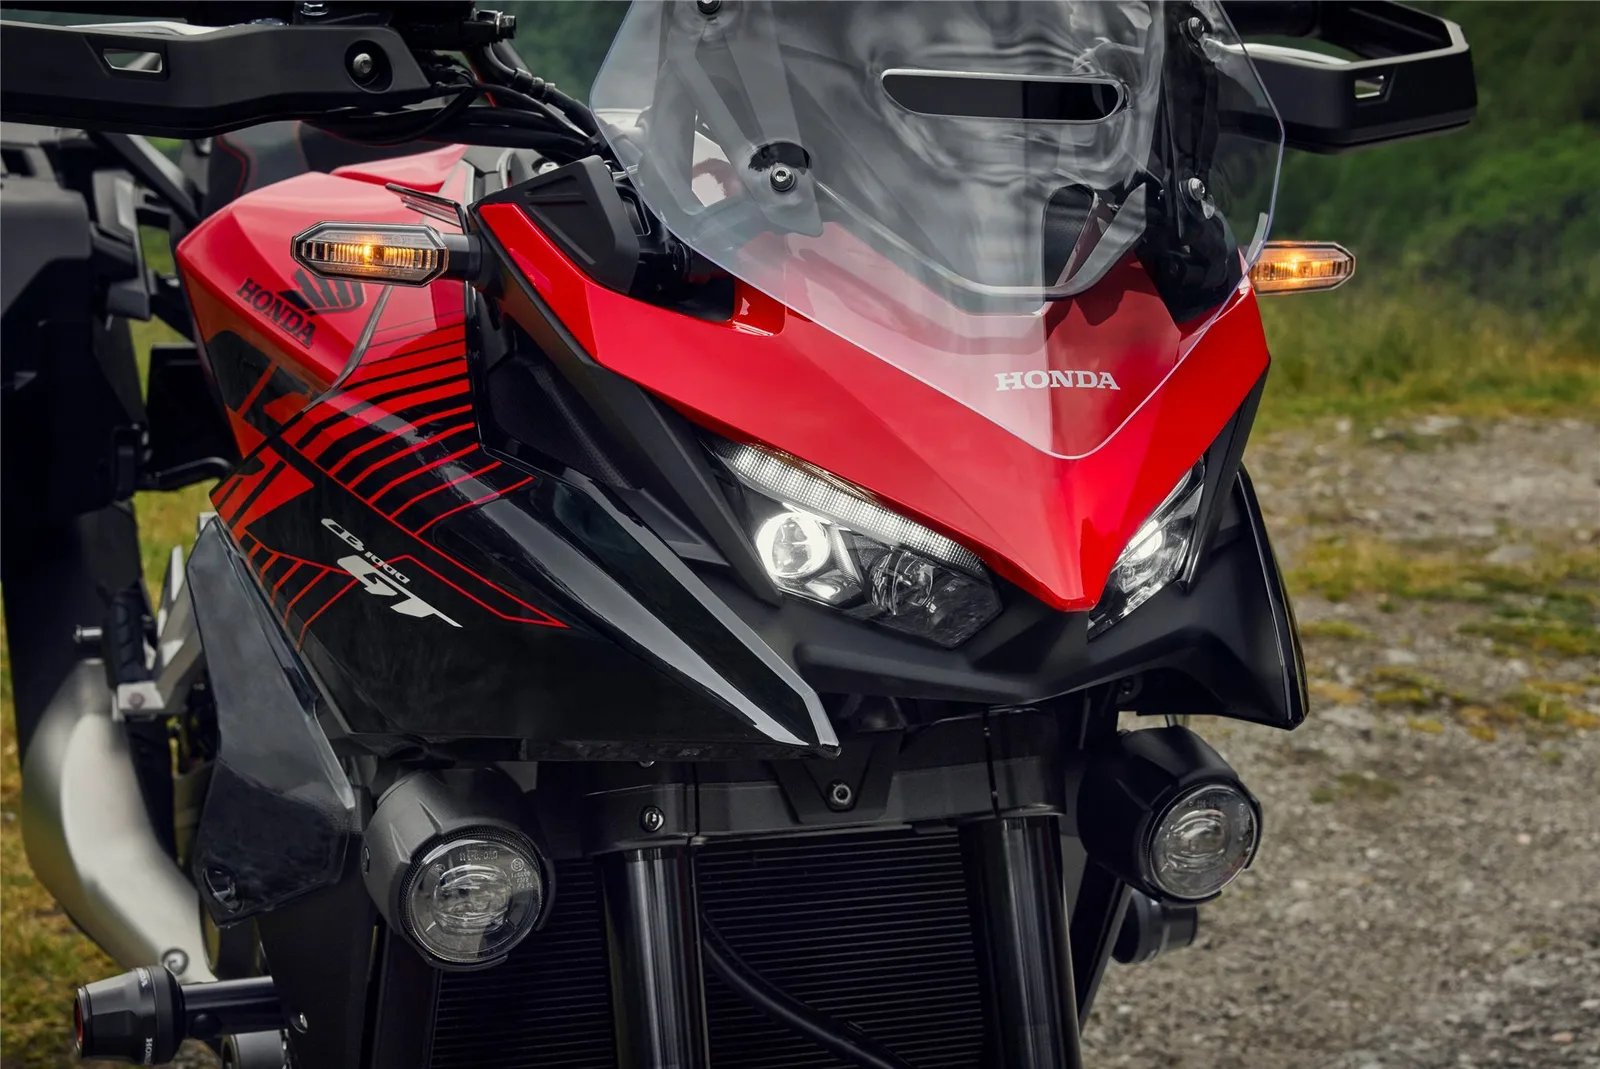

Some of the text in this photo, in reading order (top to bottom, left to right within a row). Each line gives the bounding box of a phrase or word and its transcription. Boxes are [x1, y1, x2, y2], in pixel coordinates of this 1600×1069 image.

[236, 278, 316, 349] HONDA
[994, 370, 1121, 391] HONDA
[337, 555, 463, 628] GT
